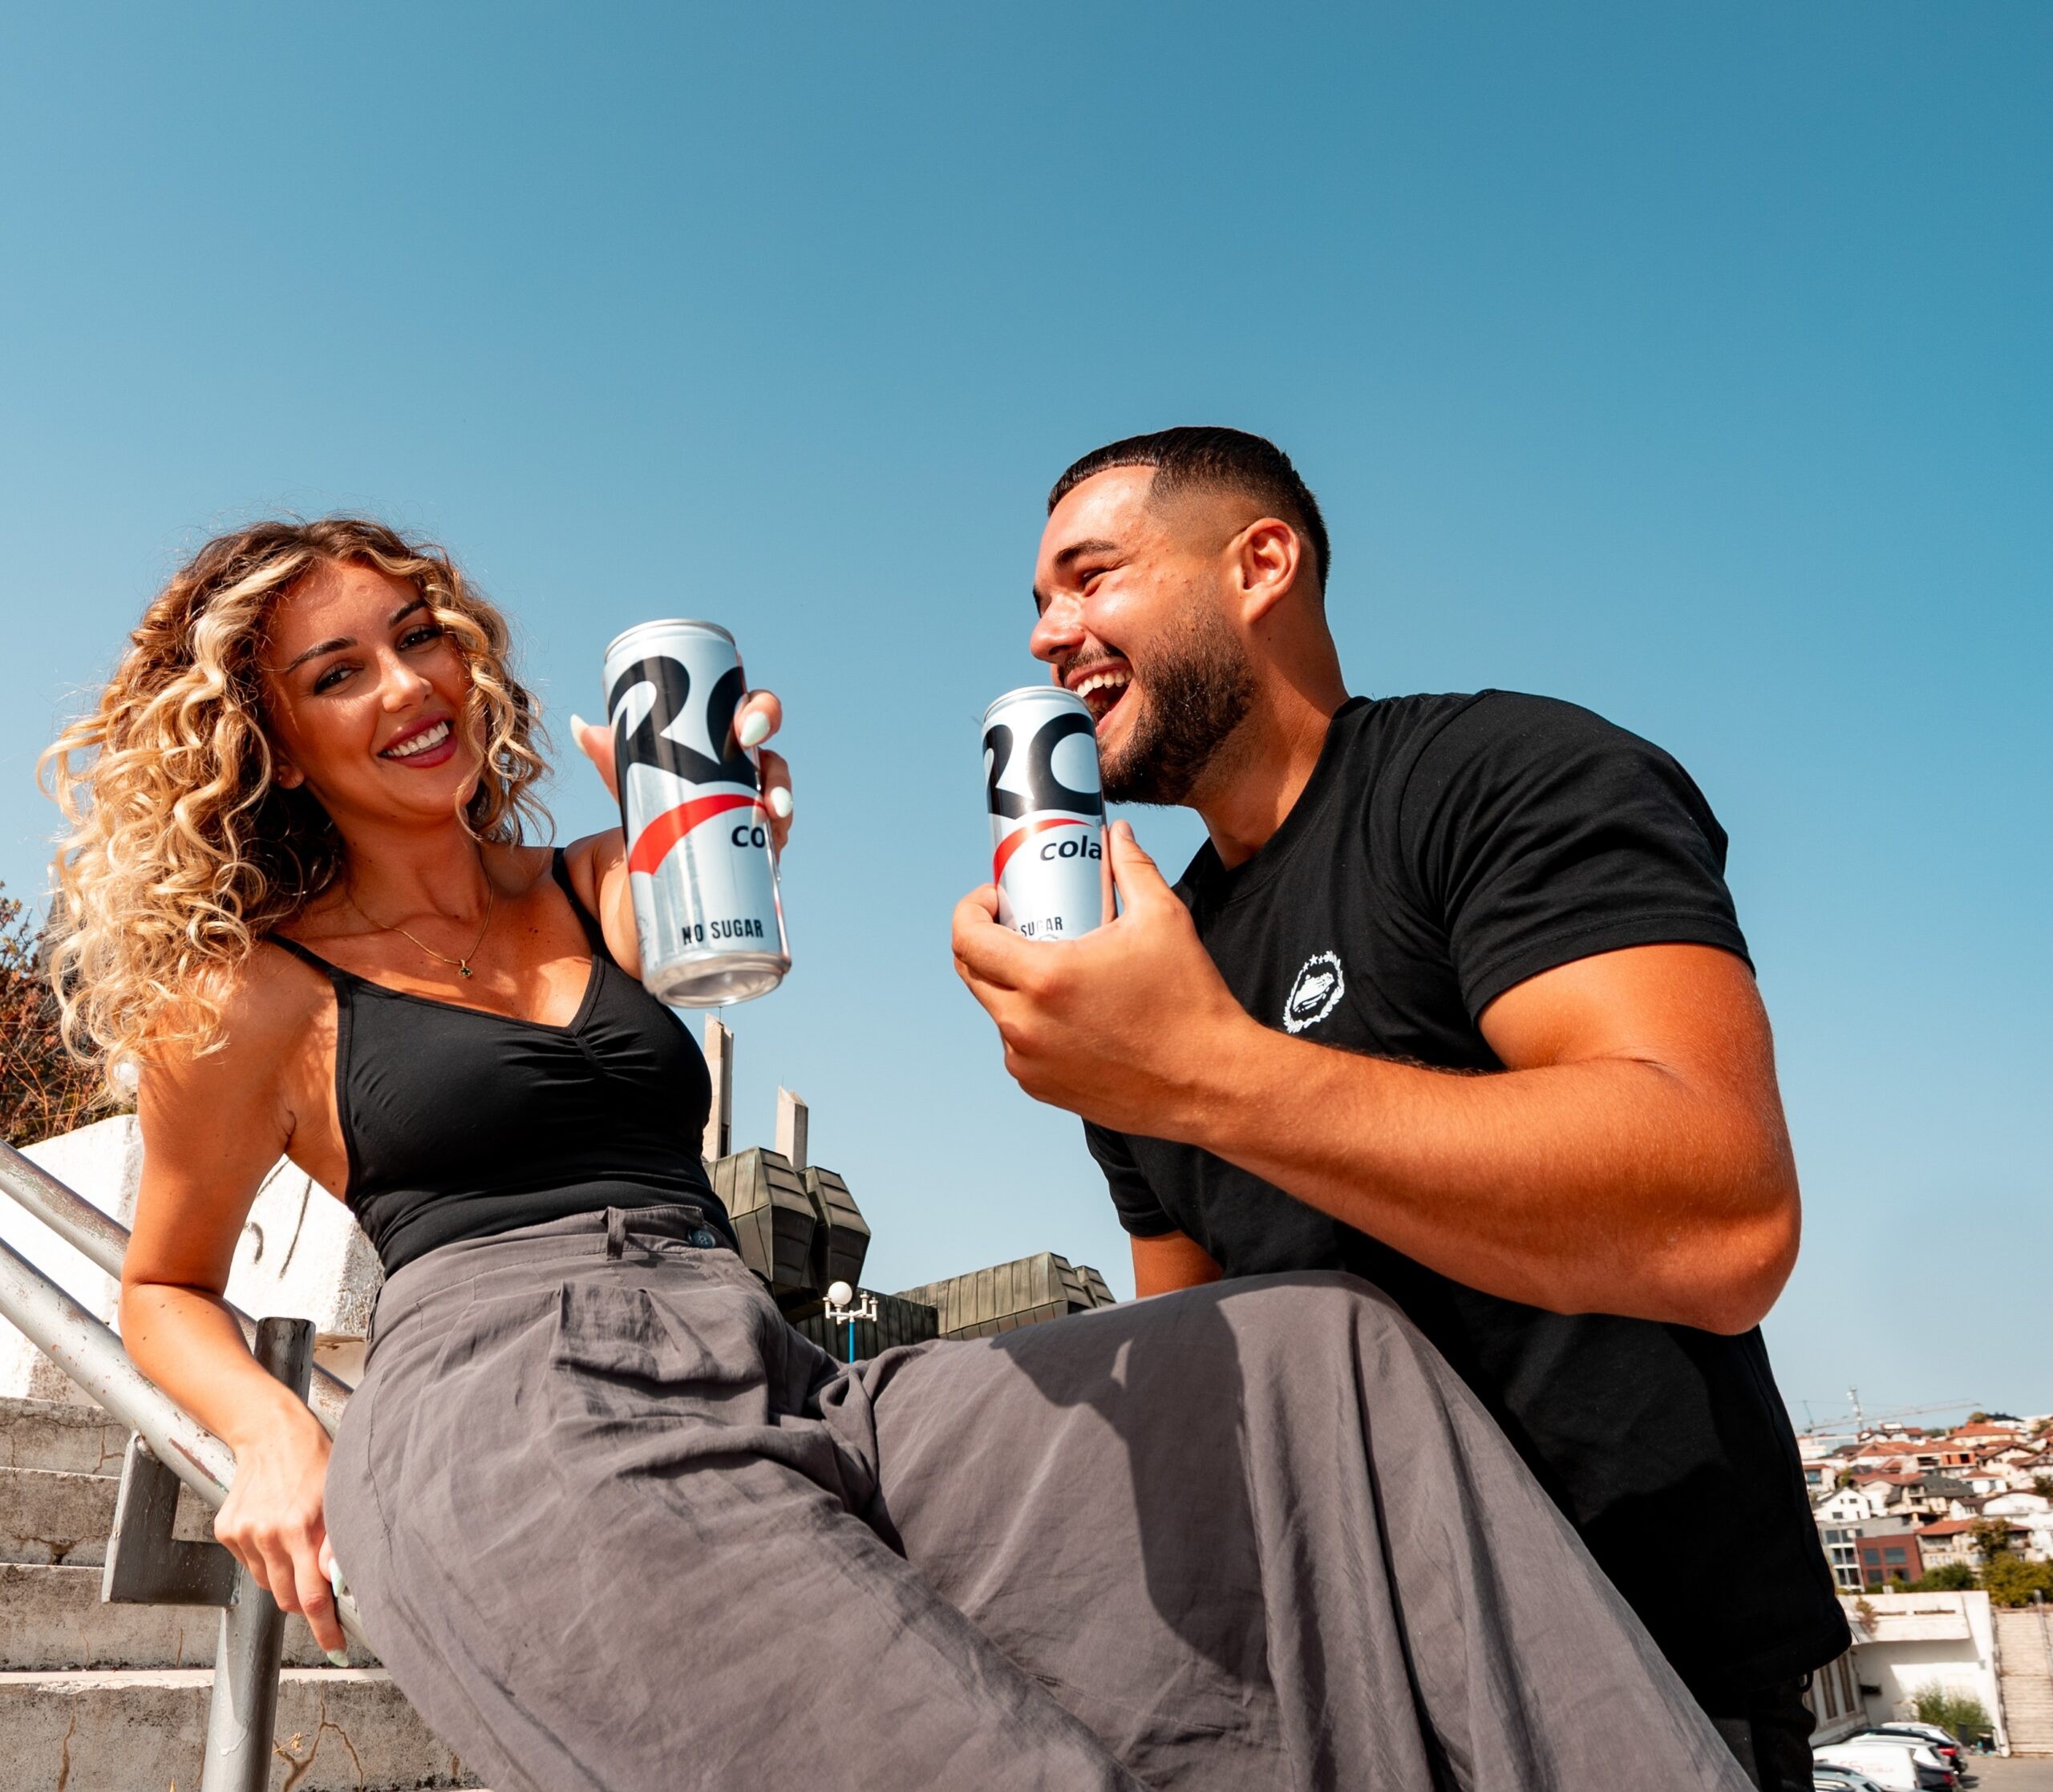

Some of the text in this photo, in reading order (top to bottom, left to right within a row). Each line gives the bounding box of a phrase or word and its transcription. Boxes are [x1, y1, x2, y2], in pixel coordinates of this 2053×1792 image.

[1039, 835, 1103, 861] cola
[682, 919, 764, 945] NO SUGAR
